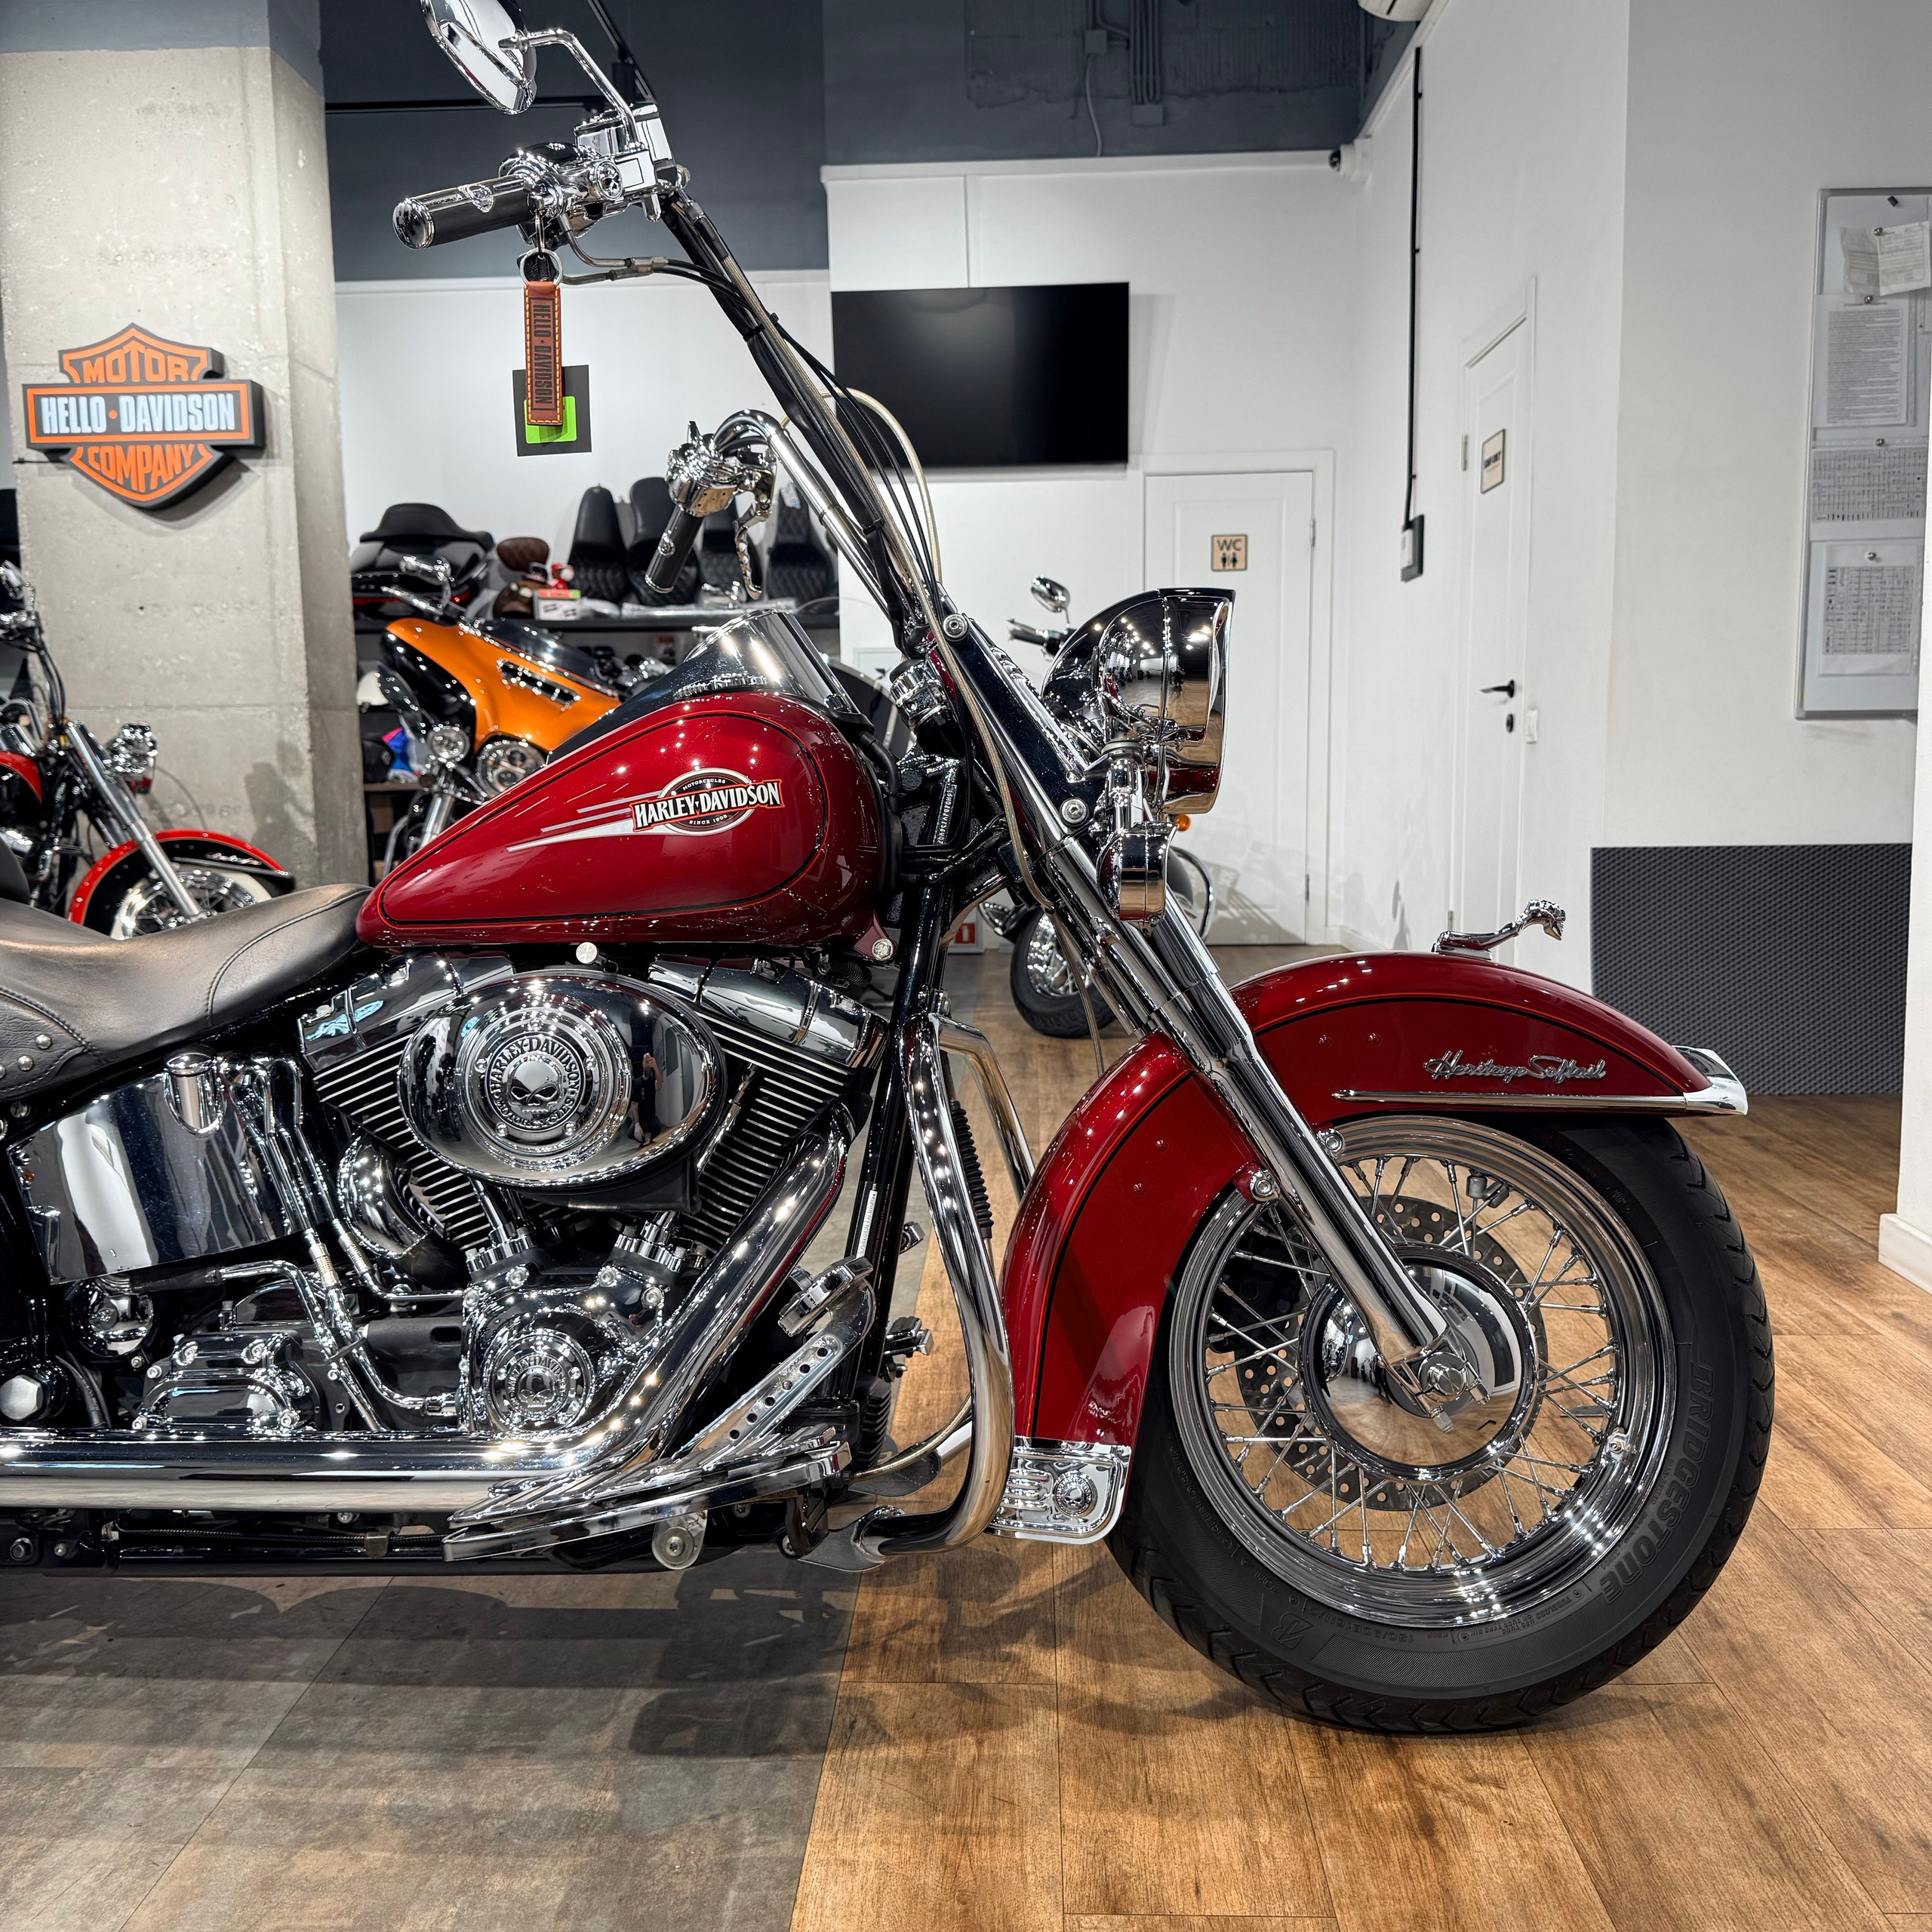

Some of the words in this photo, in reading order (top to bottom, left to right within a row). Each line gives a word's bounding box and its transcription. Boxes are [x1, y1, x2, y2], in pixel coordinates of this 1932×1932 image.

[533, 304, 551, 337] HELLO
[83, 339, 189, 383] MOTOR
[534, 345, 552, 404] DAVIDSON
[41, 395, 107, 434] HELLO
[118, 393, 235, 432] DAVIDSON
[88, 444, 195, 493] COMPANY
[1217, 539, 1241, 551] WC
[1423, 1050, 1527, 1084] Heritage
[1527, 1054, 1606, 1084] Softail
[1598, 1361, 1715, 1604] BRIDGESTONE
